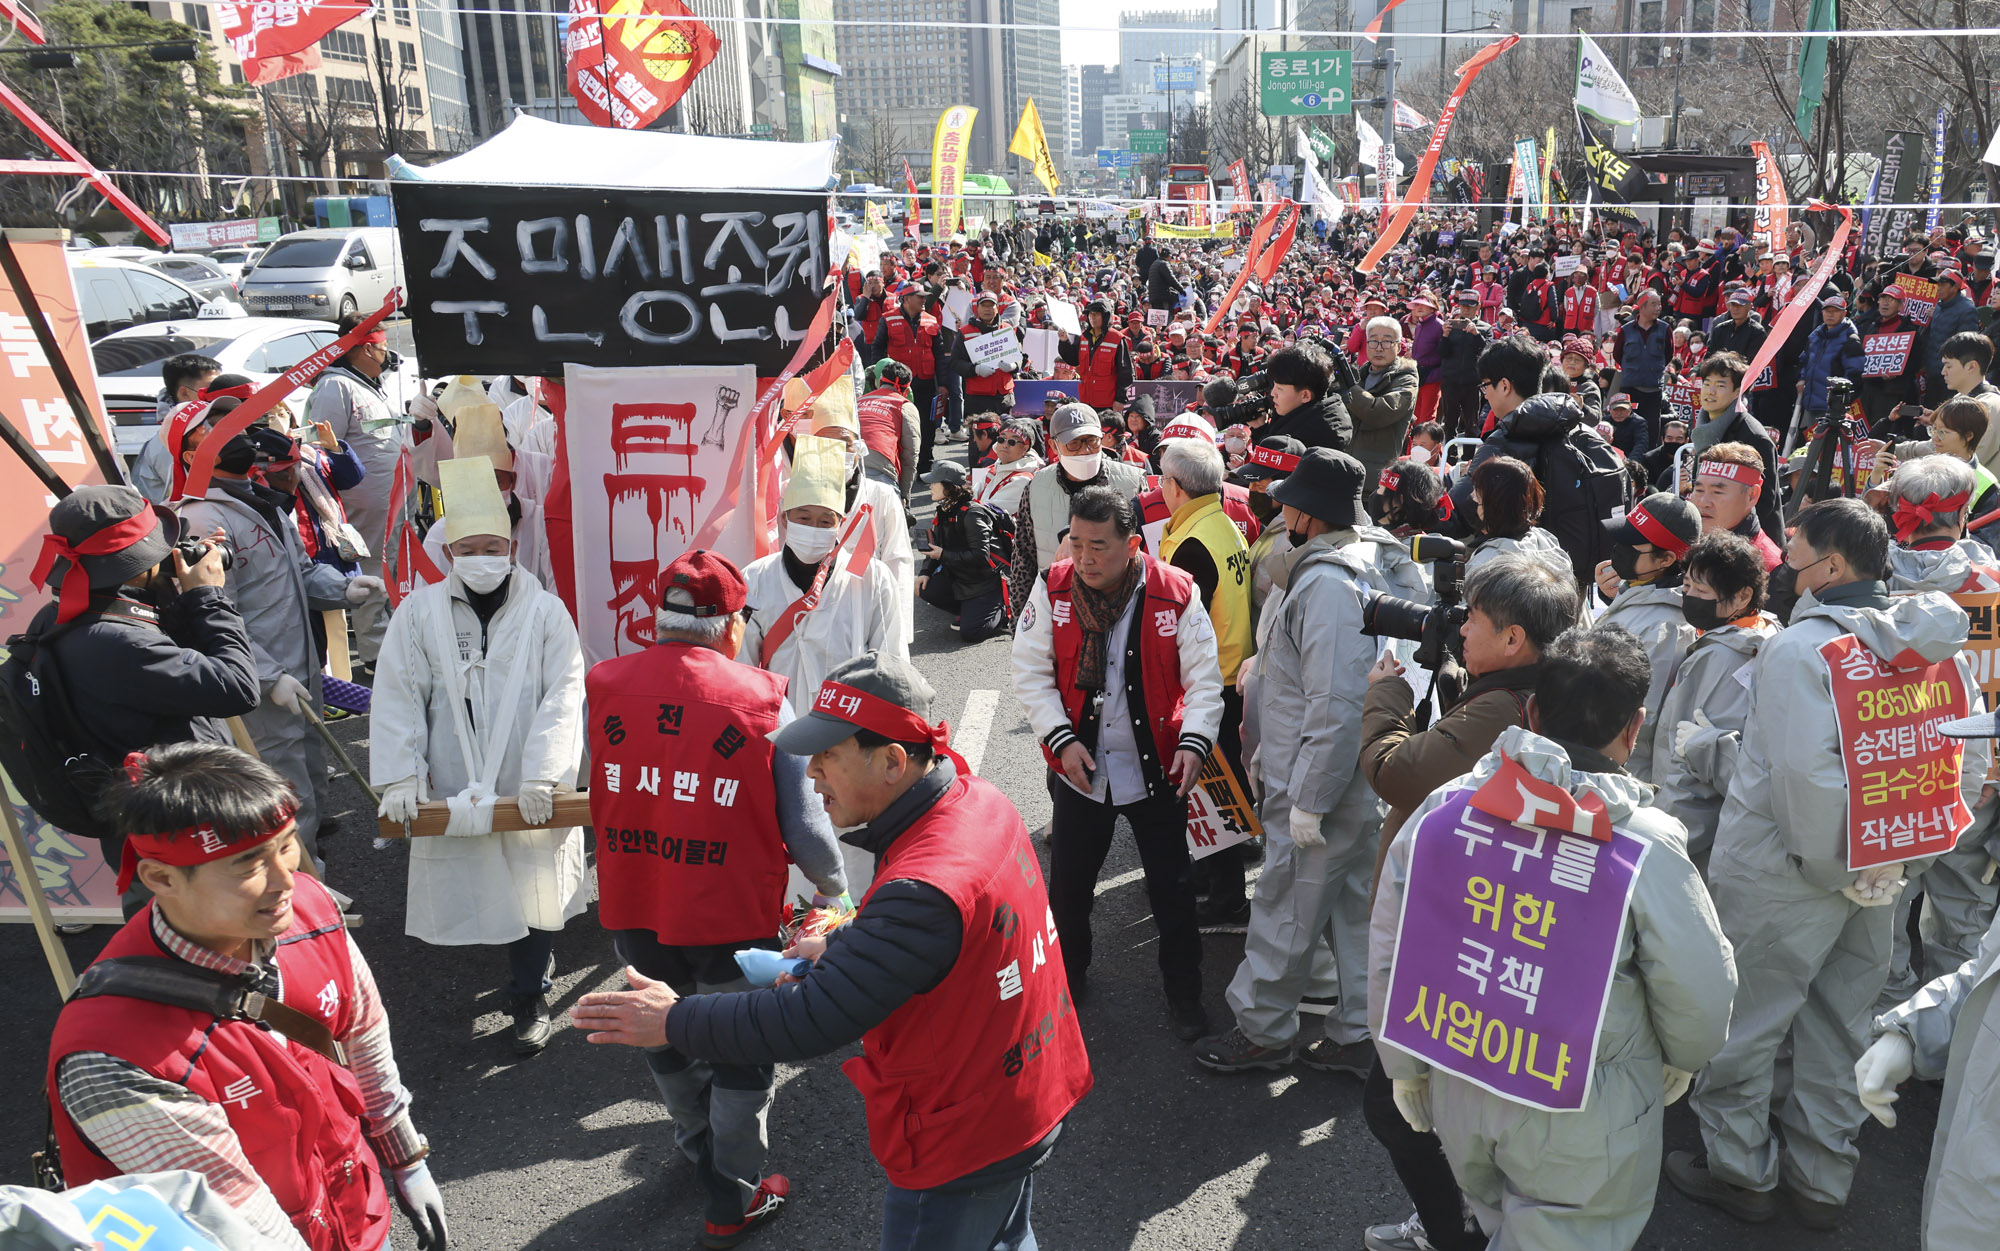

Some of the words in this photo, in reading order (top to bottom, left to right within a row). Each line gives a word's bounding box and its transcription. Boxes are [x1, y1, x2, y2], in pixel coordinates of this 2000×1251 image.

[1268, 57, 1342, 77] 종로1가
[1268, 80, 1295, 93] Jongno
[1308, 95, 1316, 105] 6
[1430, 95, 1461, 152] 결사반대
[203, 308, 224, 316] TAXI
[1864, 334, 1911, 353] 송전선로
[285, 343, 344, 387] 결사반대
[1238, 382, 1250, 391] KBS
[1052, 600, 1072, 627] 투
[1154, 608, 1178, 637] 쟁
[1856, 680, 1952, 722] 3850Km
[1853, 724, 1917, 766] 송전탑
[603, 762, 740, 808] 결사반대
[604, 826, 728, 866] 정안면어물리
[1453, 804, 1601, 894] 누구를
[1463, 875, 1558, 951] 위한
[1455, 936, 1545, 1016] 국책
[222, 1074, 264, 1111] 투
[315, 978, 341, 1019] 쟁
[1403, 984, 1572, 1092] 사업이냐
